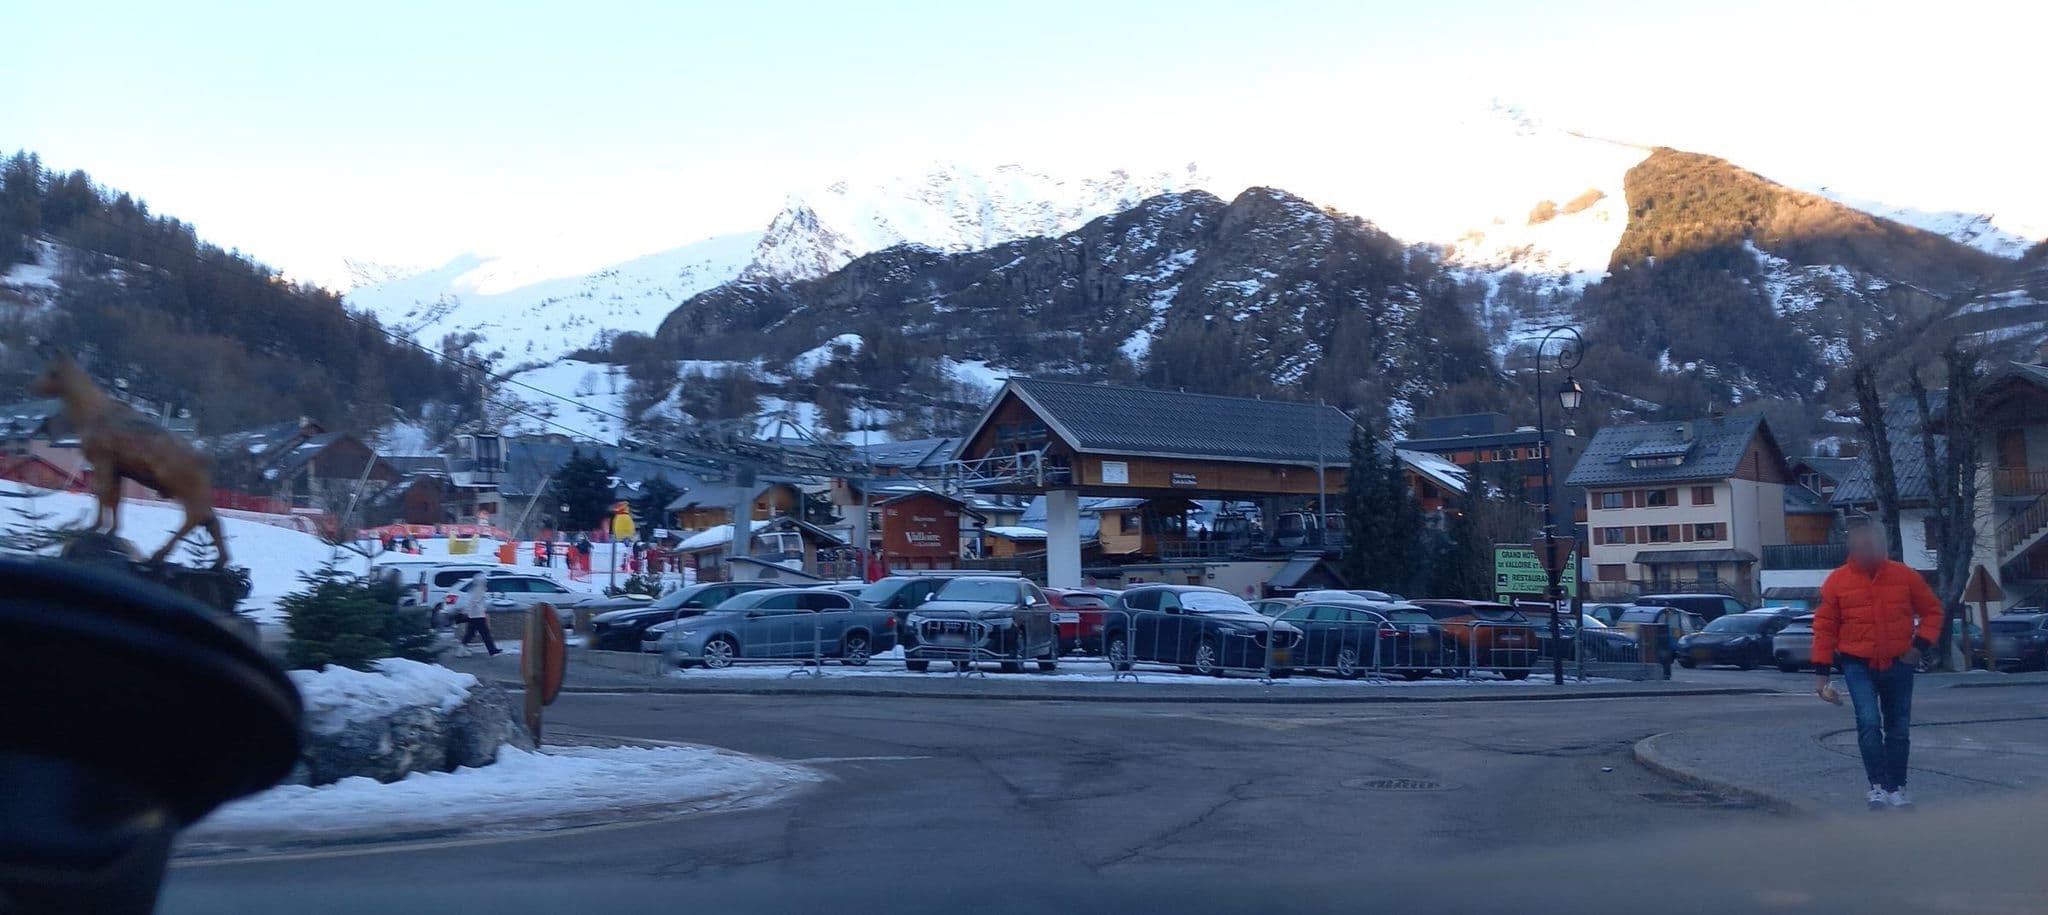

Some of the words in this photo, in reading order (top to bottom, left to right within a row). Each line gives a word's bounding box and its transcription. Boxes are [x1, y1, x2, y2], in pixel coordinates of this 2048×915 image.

[905, 531, 940, 543] Valloire
[1522, 551, 1537, 559] HOT
[1512, 573, 1548, 582] RESTAURA
